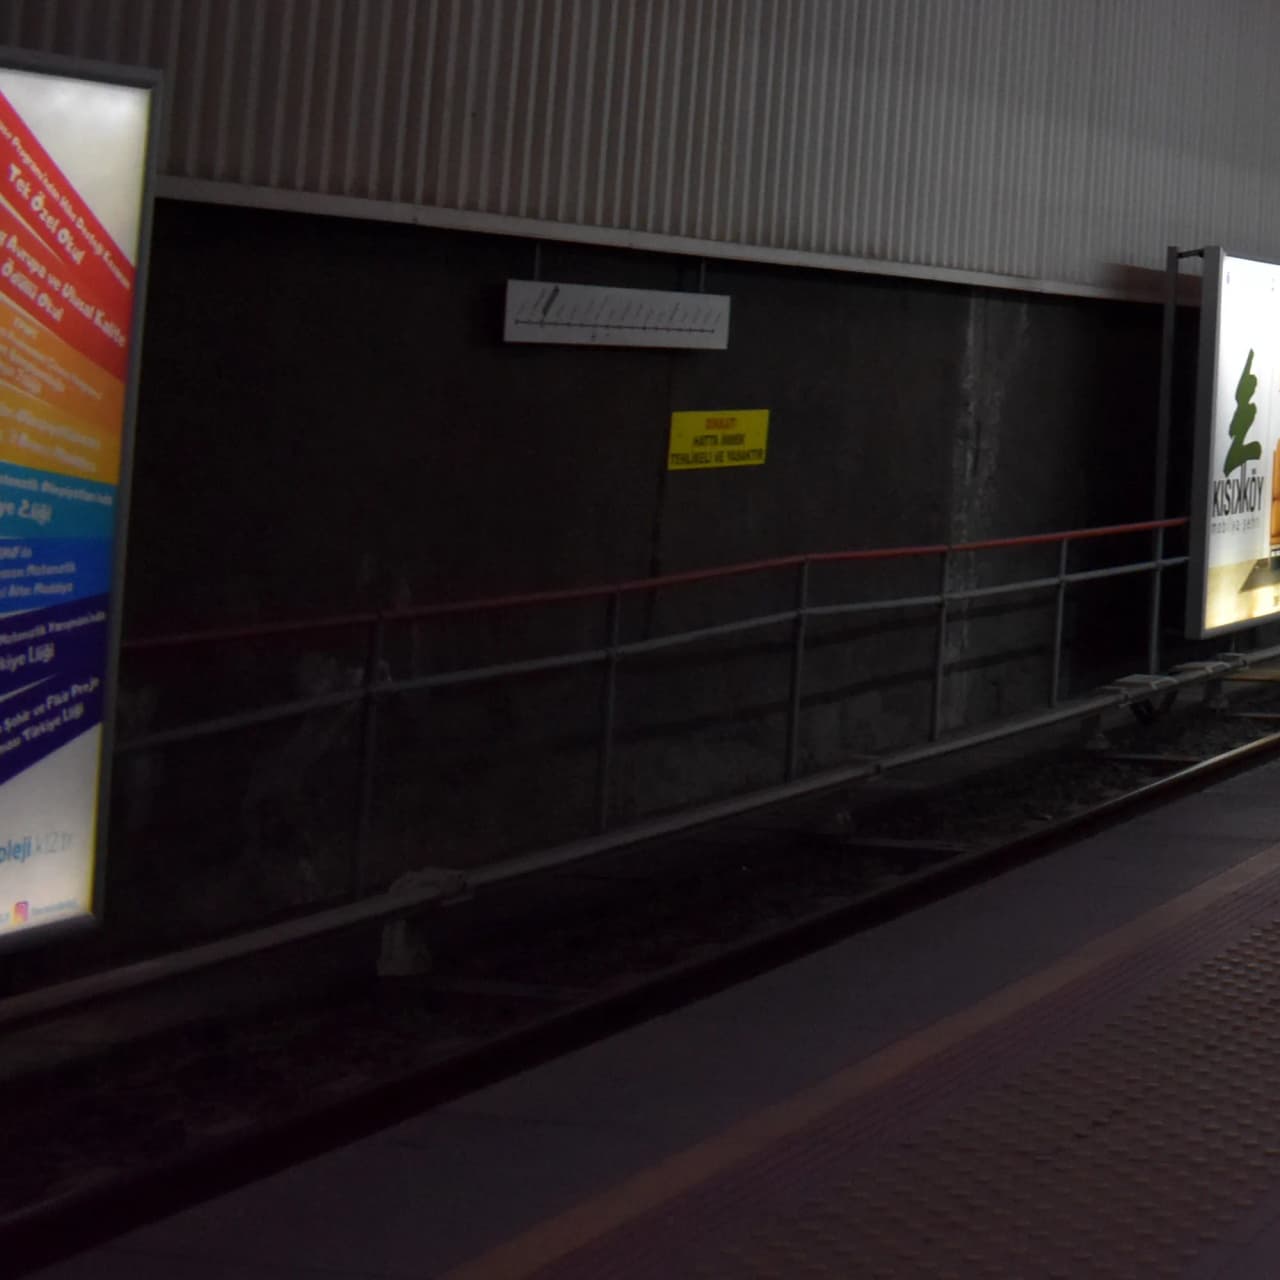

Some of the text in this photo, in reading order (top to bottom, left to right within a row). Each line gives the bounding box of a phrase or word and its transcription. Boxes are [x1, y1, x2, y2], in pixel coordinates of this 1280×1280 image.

[9, 163, 86, 265] Tek Özel Okul
[6, 234, 47, 279] Avrupa
[61, 282, 95, 319] Ulusal
[93, 308, 127, 347] Kalite
